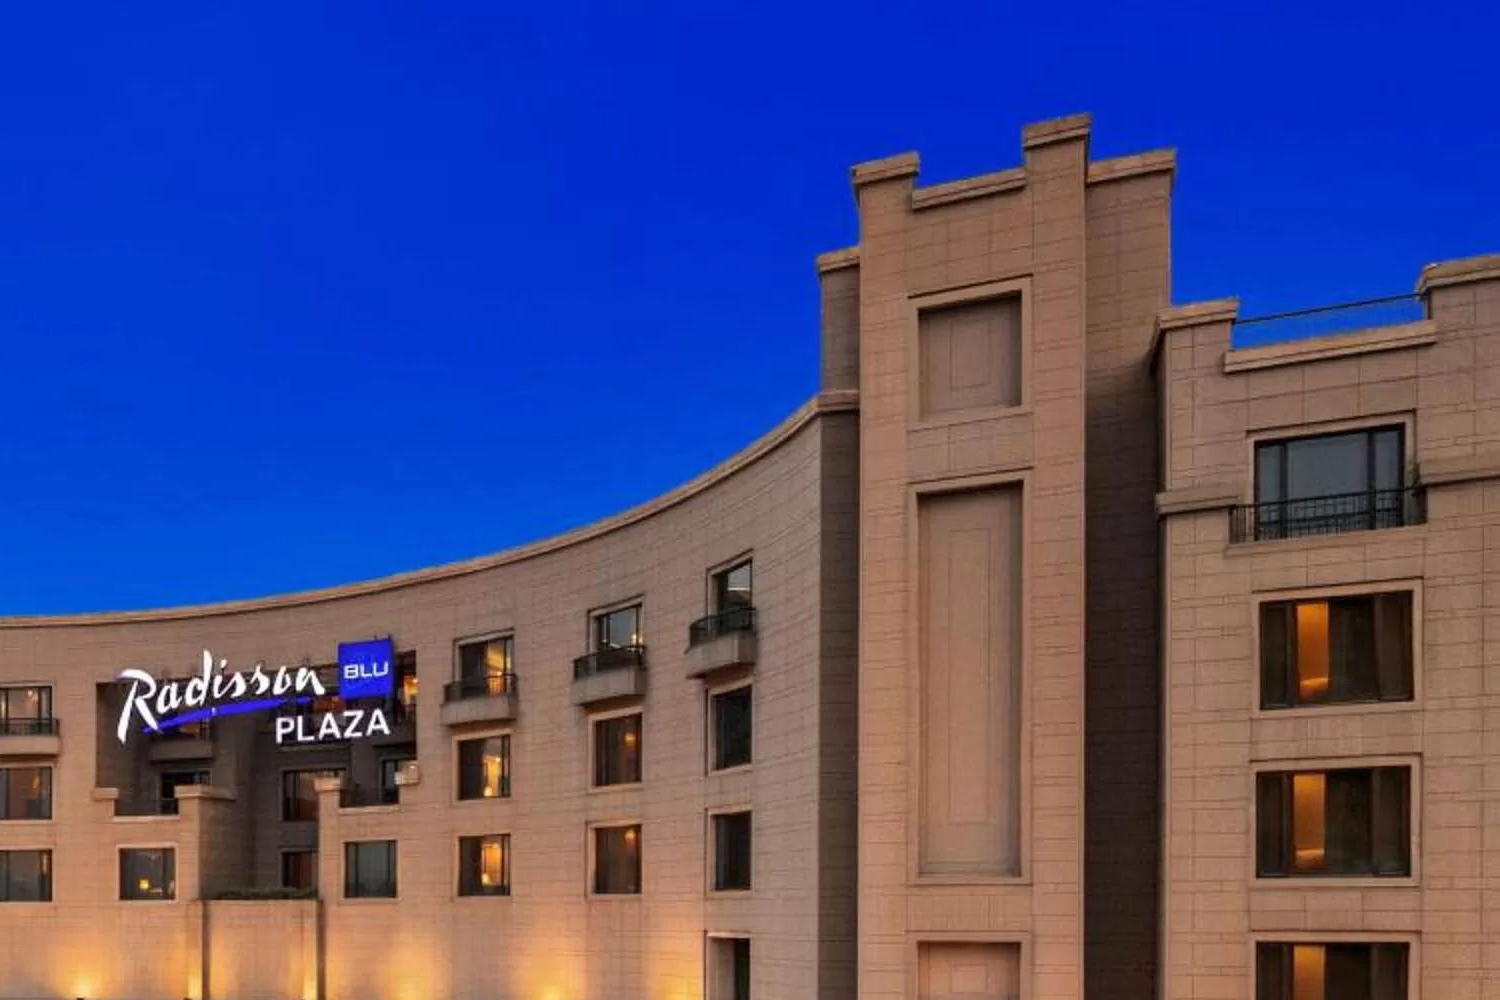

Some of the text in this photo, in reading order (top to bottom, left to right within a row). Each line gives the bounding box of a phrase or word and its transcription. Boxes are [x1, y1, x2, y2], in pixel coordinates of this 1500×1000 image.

[116, 650, 389, 744] Radisson BLU
[275, 707, 391, 744] PLAZA
